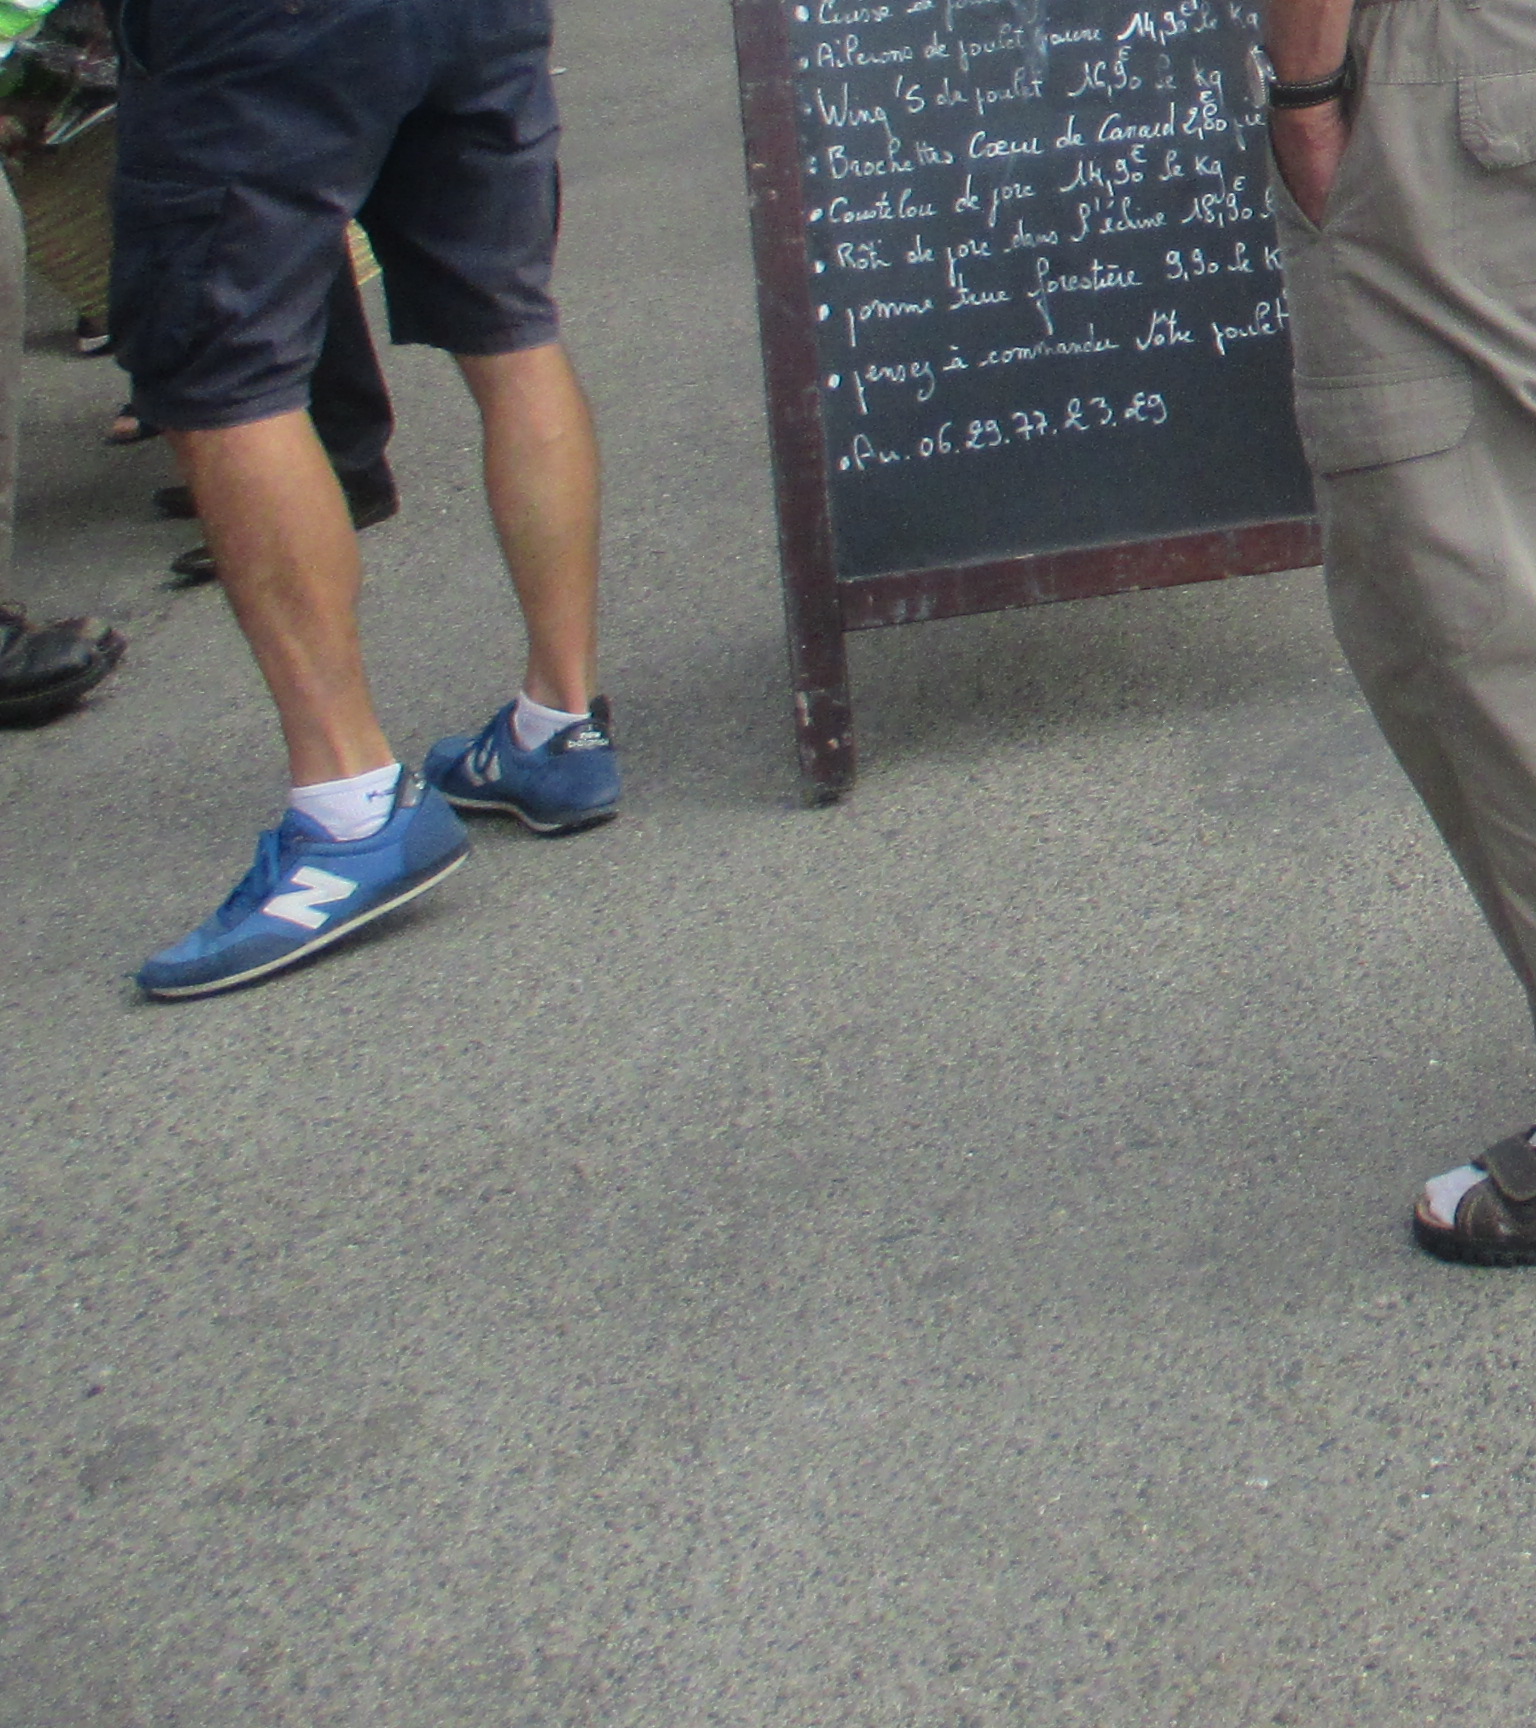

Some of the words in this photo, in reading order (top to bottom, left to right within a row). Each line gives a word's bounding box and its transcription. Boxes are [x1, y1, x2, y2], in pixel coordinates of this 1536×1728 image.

[924, 31, 951, 59] de
[937, 78, 968, 105] de
[1056, 115, 1086, 148] de
[1099, 102, 1176, 142] Canard
[954, 174, 980, 212] de
[1160, 150, 1185, 181] le
[907, 235, 934, 265] de
[1228, 243, 1253, 272] le
[944, 345, 969, 370] à
